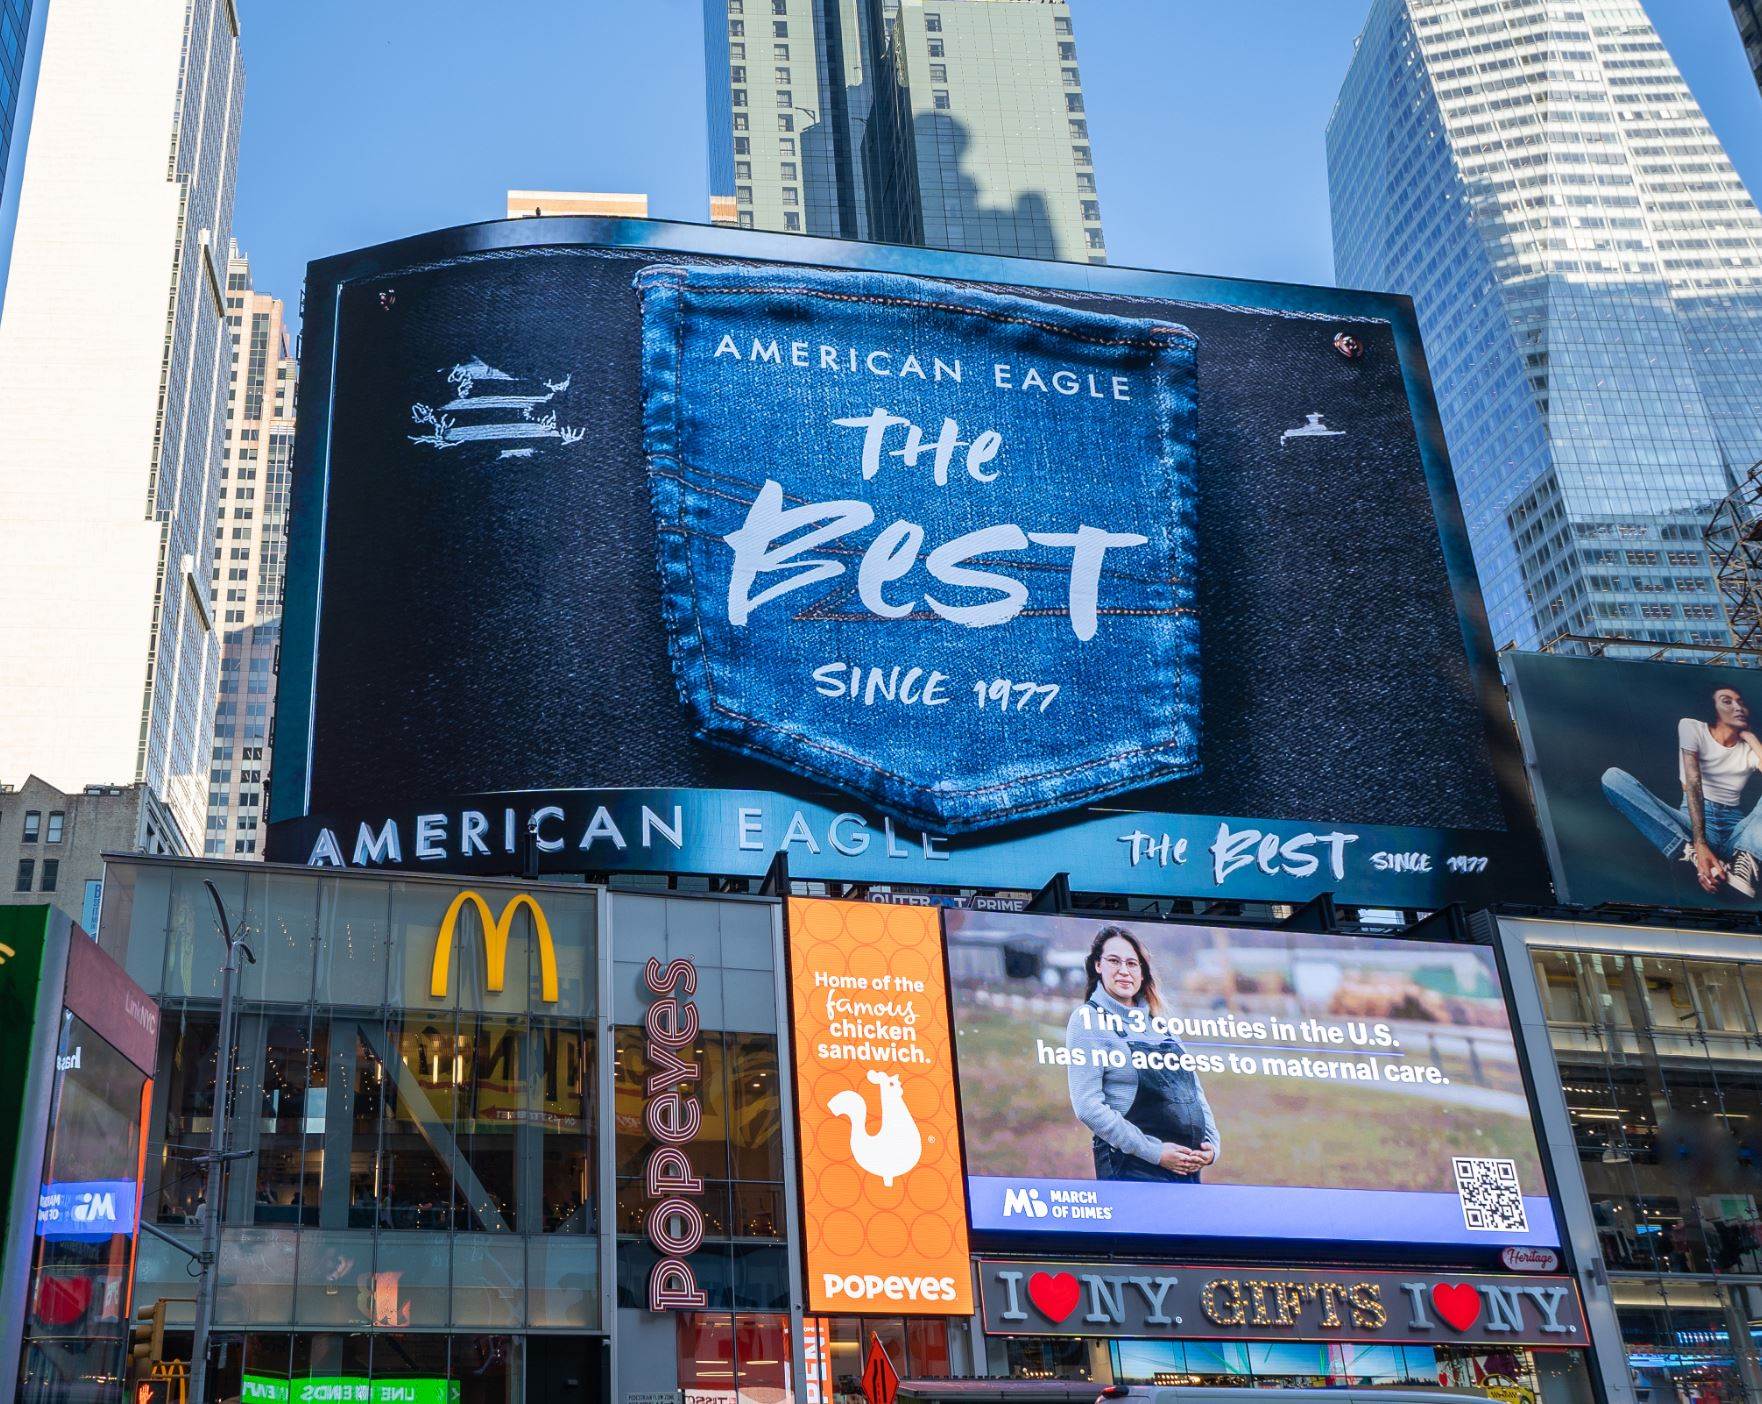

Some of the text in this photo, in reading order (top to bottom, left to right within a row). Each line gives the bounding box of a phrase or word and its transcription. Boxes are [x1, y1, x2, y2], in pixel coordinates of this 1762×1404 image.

[714, 334, 1132, 401] AMERICAN EAGLE
[811, 661, 1061, 713] SINCE 1977
[307, 804, 950, 867] AMERICAN EAGLE
[1369, 850, 1433, 873] SINCE
[1445, 855, 1489, 875] 1977
[976, 899, 1024, 912] PRIME
[814, 971, 925, 992] Home of the
[825, 988, 920, 1025] famous
[829, 1018, 917, 1041] chicken
[1078, 1007, 1401, 1048] 1 in 3 counties in the U.S.
[817, 1041, 931, 1064] sandwich.
[1036, 1039, 1452, 1086] has no access to maternal care.
[1050, 1190, 1098, 1204] MARCH
[1051, 1205, 1113, 1220] OF DIMES
[1505, 1248, 1553, 1269] Heritage
[999, 1270, 1029, 1320] I
[1201, 1277, 1389, 1330] GIFTS
[1400, 1281, 1434, 1330] I
